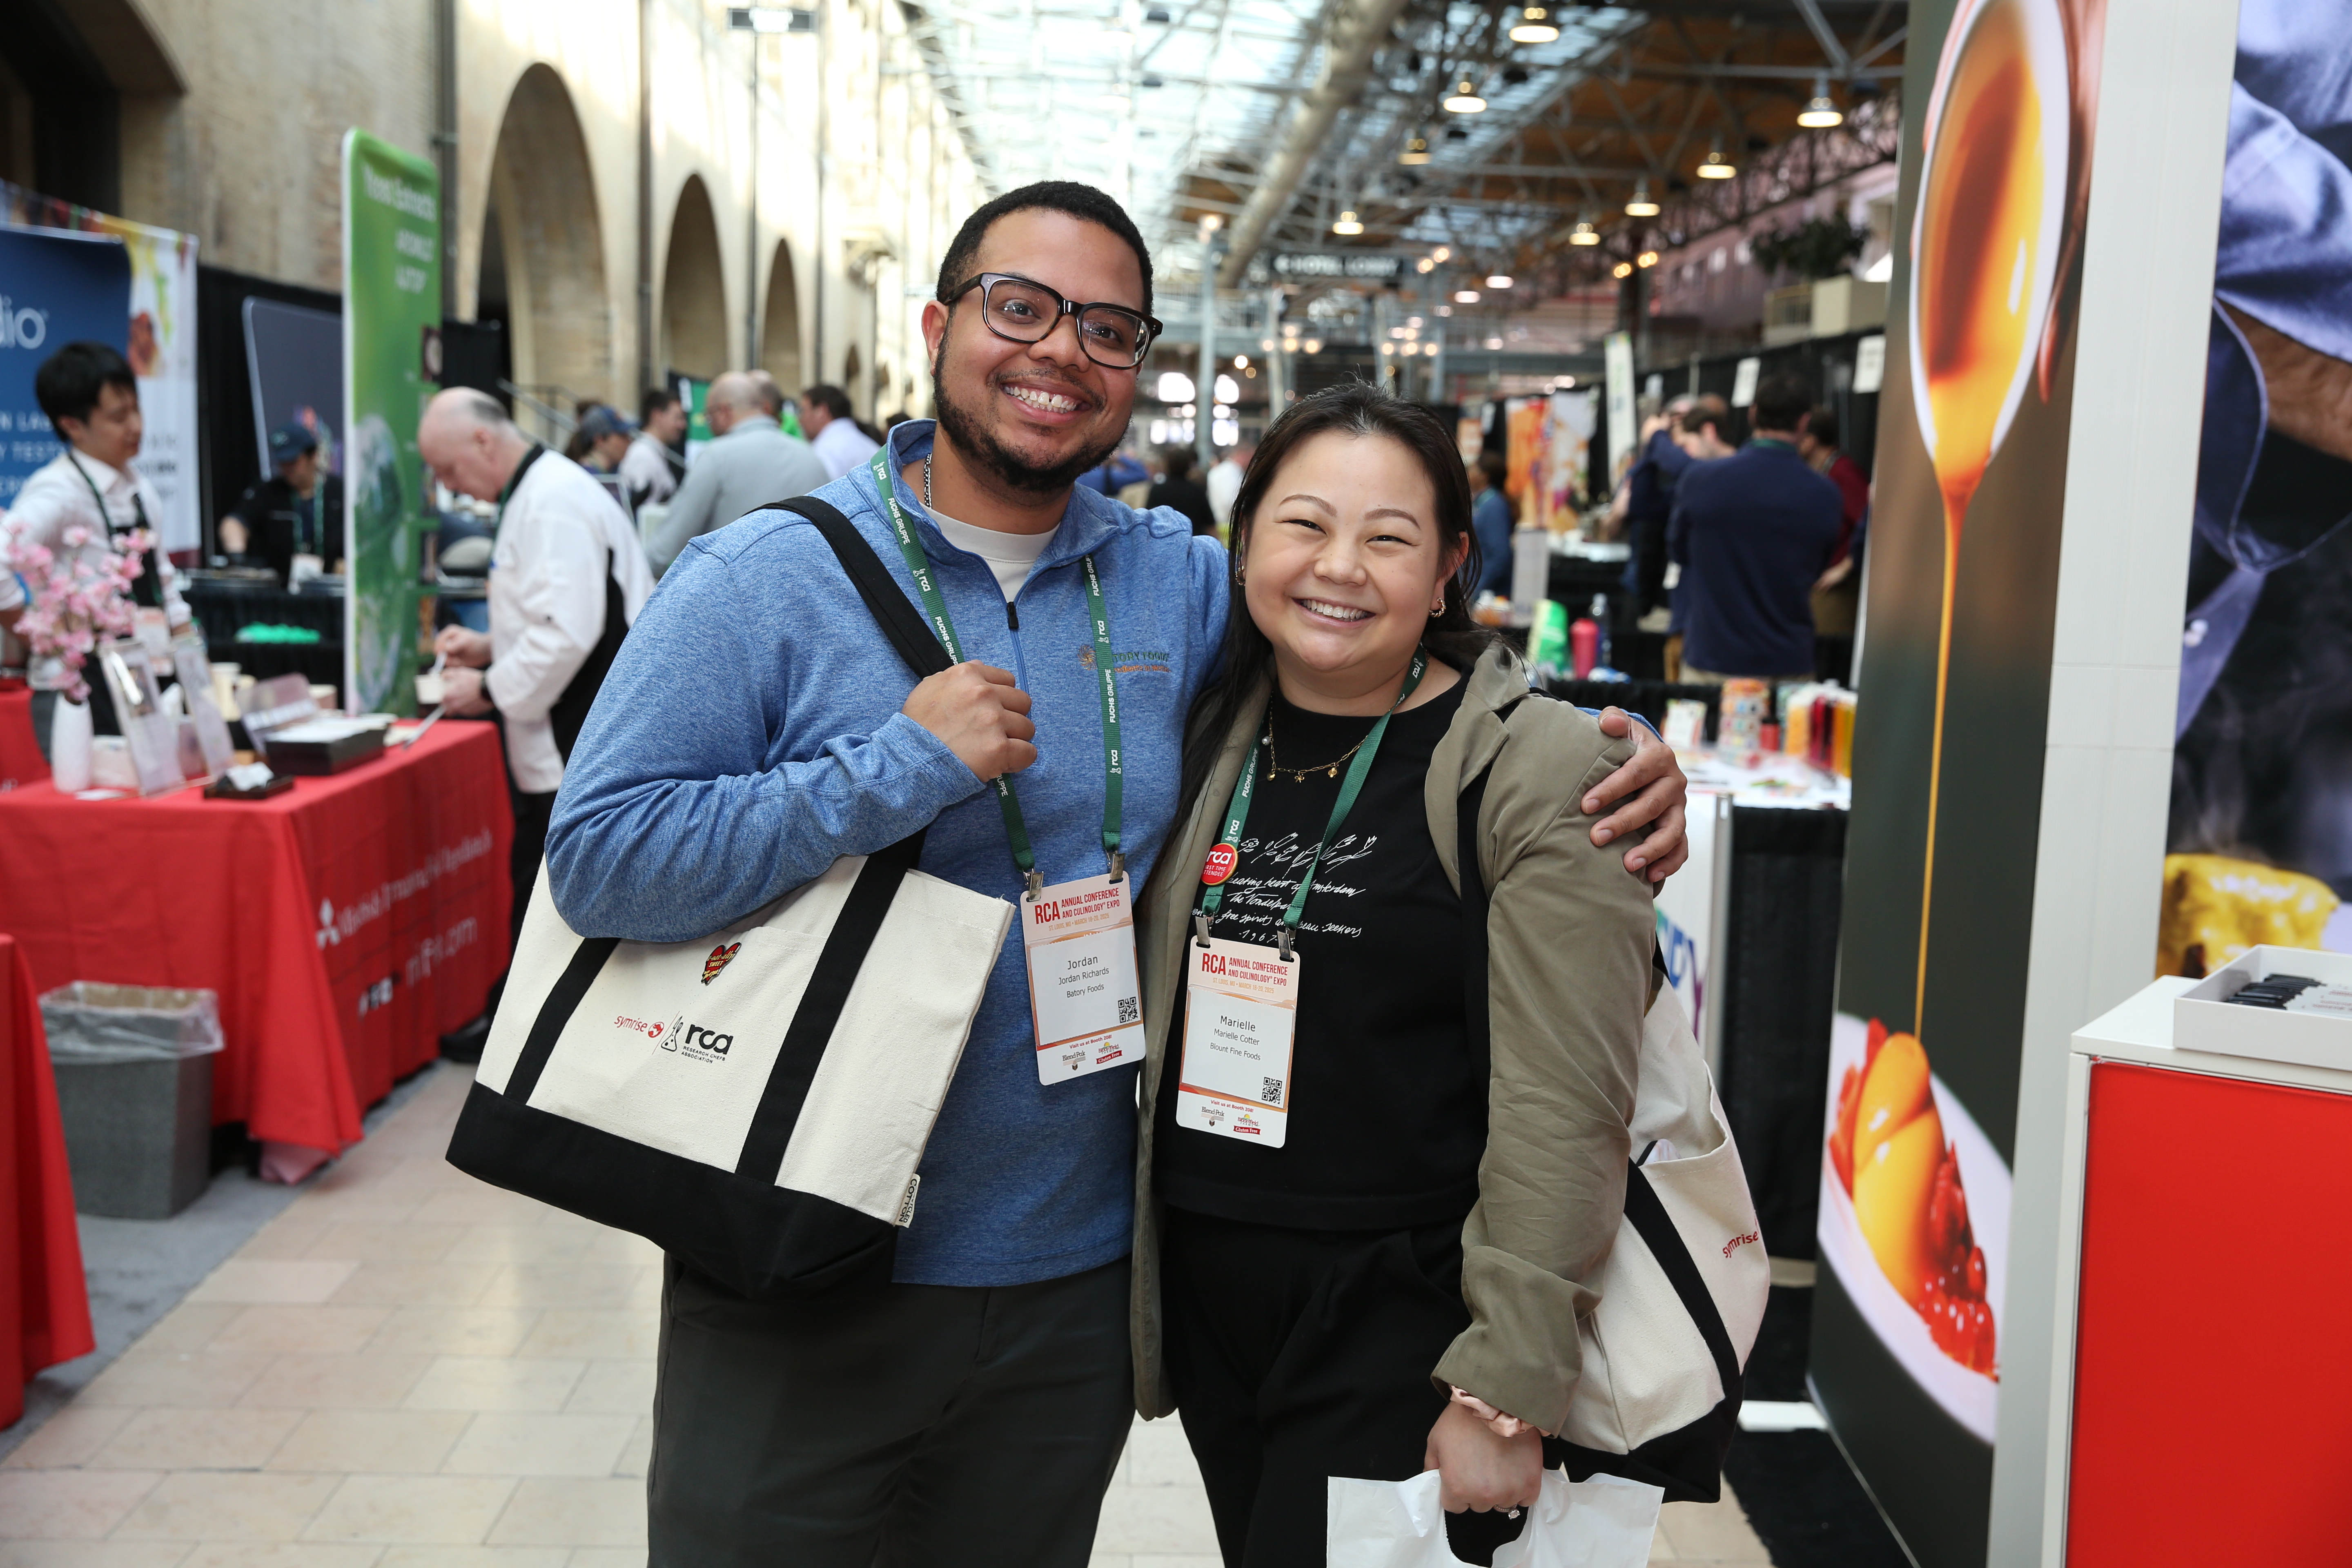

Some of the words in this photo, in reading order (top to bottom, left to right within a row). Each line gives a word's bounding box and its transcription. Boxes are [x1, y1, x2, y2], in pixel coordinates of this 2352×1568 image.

[875, 466, 887, 481] rca
[888, 497, 901, 520] FUCHS
[895, 518, 910, 545] GRUPPE
[1085, 555, 1094, 573] GRUP
[919, 575, 931, 591] rca
[1090, 574, 1100, 596] FUCHS
[1097, 620, 1106, 635] rca
[935, 616, 950, 641] FUCHS
[945, 641, 958, 665] GRUPP
[1112, 652, 1139, 663] TORY
[1412, 664, 1421, 679] rca
[1105, 669, 1114, 696] GRUPPE
[1108, 697, 1116, 723] FUCHS
[1242, 774, 1252, 798] FUCHS
[1248, 748, 1258, 775] GRUPPE
[1229, 820, 1240, 835] rca
[1206, 851, 1232, 865] rca
[1264, 877, 1297, 888] heart
[1062, 895, 1083, 908] ANNUAL
[1084, 888, 1119, 903] CONFERENCE
[1034, 901, 1060, 924] RCA
[1062, 910, 1073, 919] AND
[1107, 899, 1120, 909] EXPO
[1215, 909, 1239, 924] free
[1239, 913, 1273, 926] spirits
[1054, 922, 1065, 930] LOUIS,
[1067, 956, 1098, 970] Jordan
[1202, 953, 1226, 975] RCA
[1229, 957, 1251, 969] ANNUAL
[1252, 962, 1288, 976] CONFERENCE
[1058, 973, 1081, 985] Jordan
[1082, 967, 1109, 979] Richards
[1228, 969, 1238, 978] AND
[1273, 977, 1287, 986] EXPO
[1067, 988, 1085, 998] Batory
[1087, 984, 1104, 993] Foods
[614, 1016, 648, 1032] symrise
[1220, 1016, 1256, 1032] Marielle
[685, 1024, 734, 1055] rca
[1214, 1029, 1238, 1040] Marielle
[1240, 1034, 1260, 1046] Cotter
[683, 1046, 708, 1057] RESEARCH
[1098, 1044, 1119, 1053] Bloomfield
[1210, 1042, 1228, 1053] Blount
[1230, 1047, 1242, 1056] Fine
[1243, 1051, 1261, 1061] Foods
[681, 1051, 713, 1064] ASSOCIATION
[1238, 1117, 1259, 1126] Bloomfield
[899, 1178, 917, 1222] COTTON
[1722, 1231, 1759, 1258] symrise
